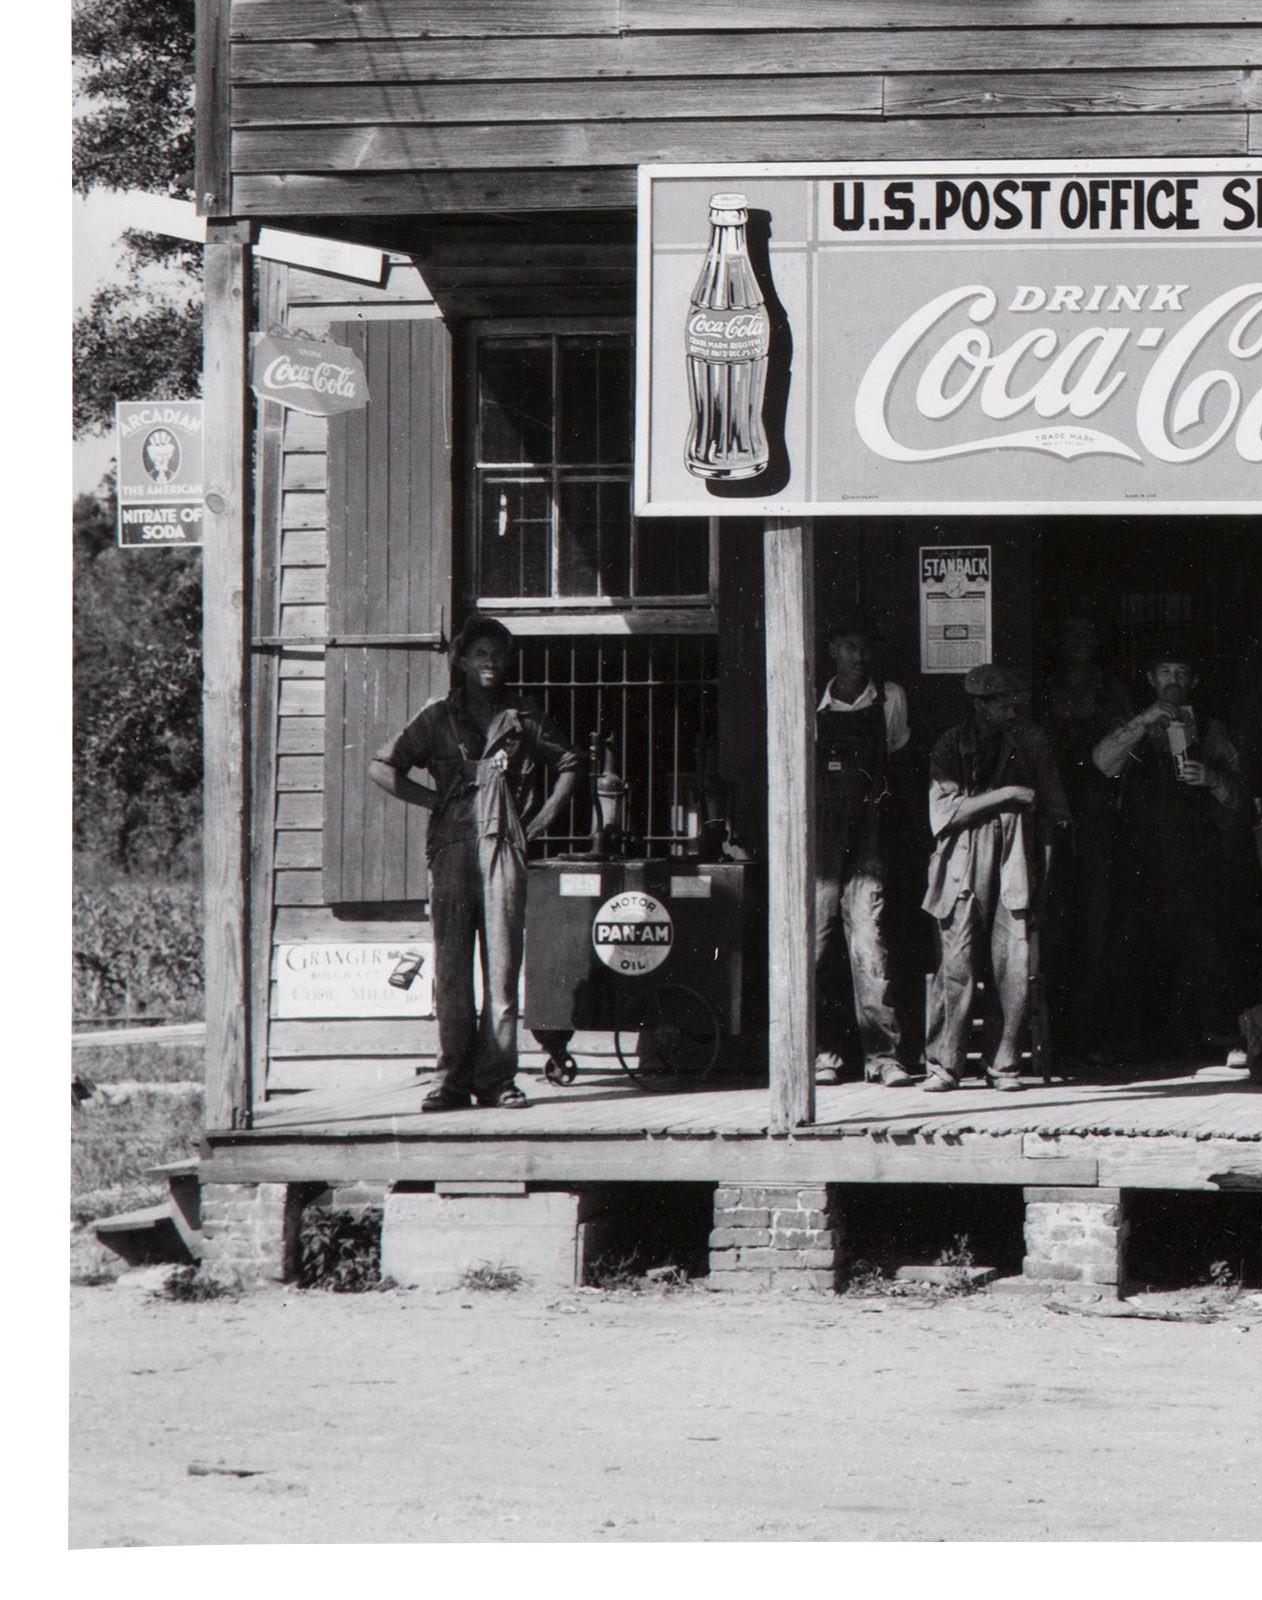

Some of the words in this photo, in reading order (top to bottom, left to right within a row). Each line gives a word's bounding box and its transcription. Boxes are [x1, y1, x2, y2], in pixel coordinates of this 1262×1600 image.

[936, 179, 1053, 231] POST
[1060, 177, 1200, 231] OFFICE
[1008, 283, 1191, 312] DRINK
[688, 313, 765, 339] Coca-Cola
[263, 354, 357, 399] Coca-Cola
[119, 407, 203, 438] ARCADIAN
[121, 483, 145, 497] THE
[147, 483, 203, 496] AMERICAN
[122, 508, 177, 525] NITRATE
[180, 507, 203, 523] OF
[142, 523, 186, 540] SODA
[923, 558, 988, 576] STANBACK
[610, 896, 657, 913] MOTOR
[597, 924, 669, 942] PAN-AM
[285, 945, 383, 972] GRANGER
[620, 959, 646, 971] OIL
